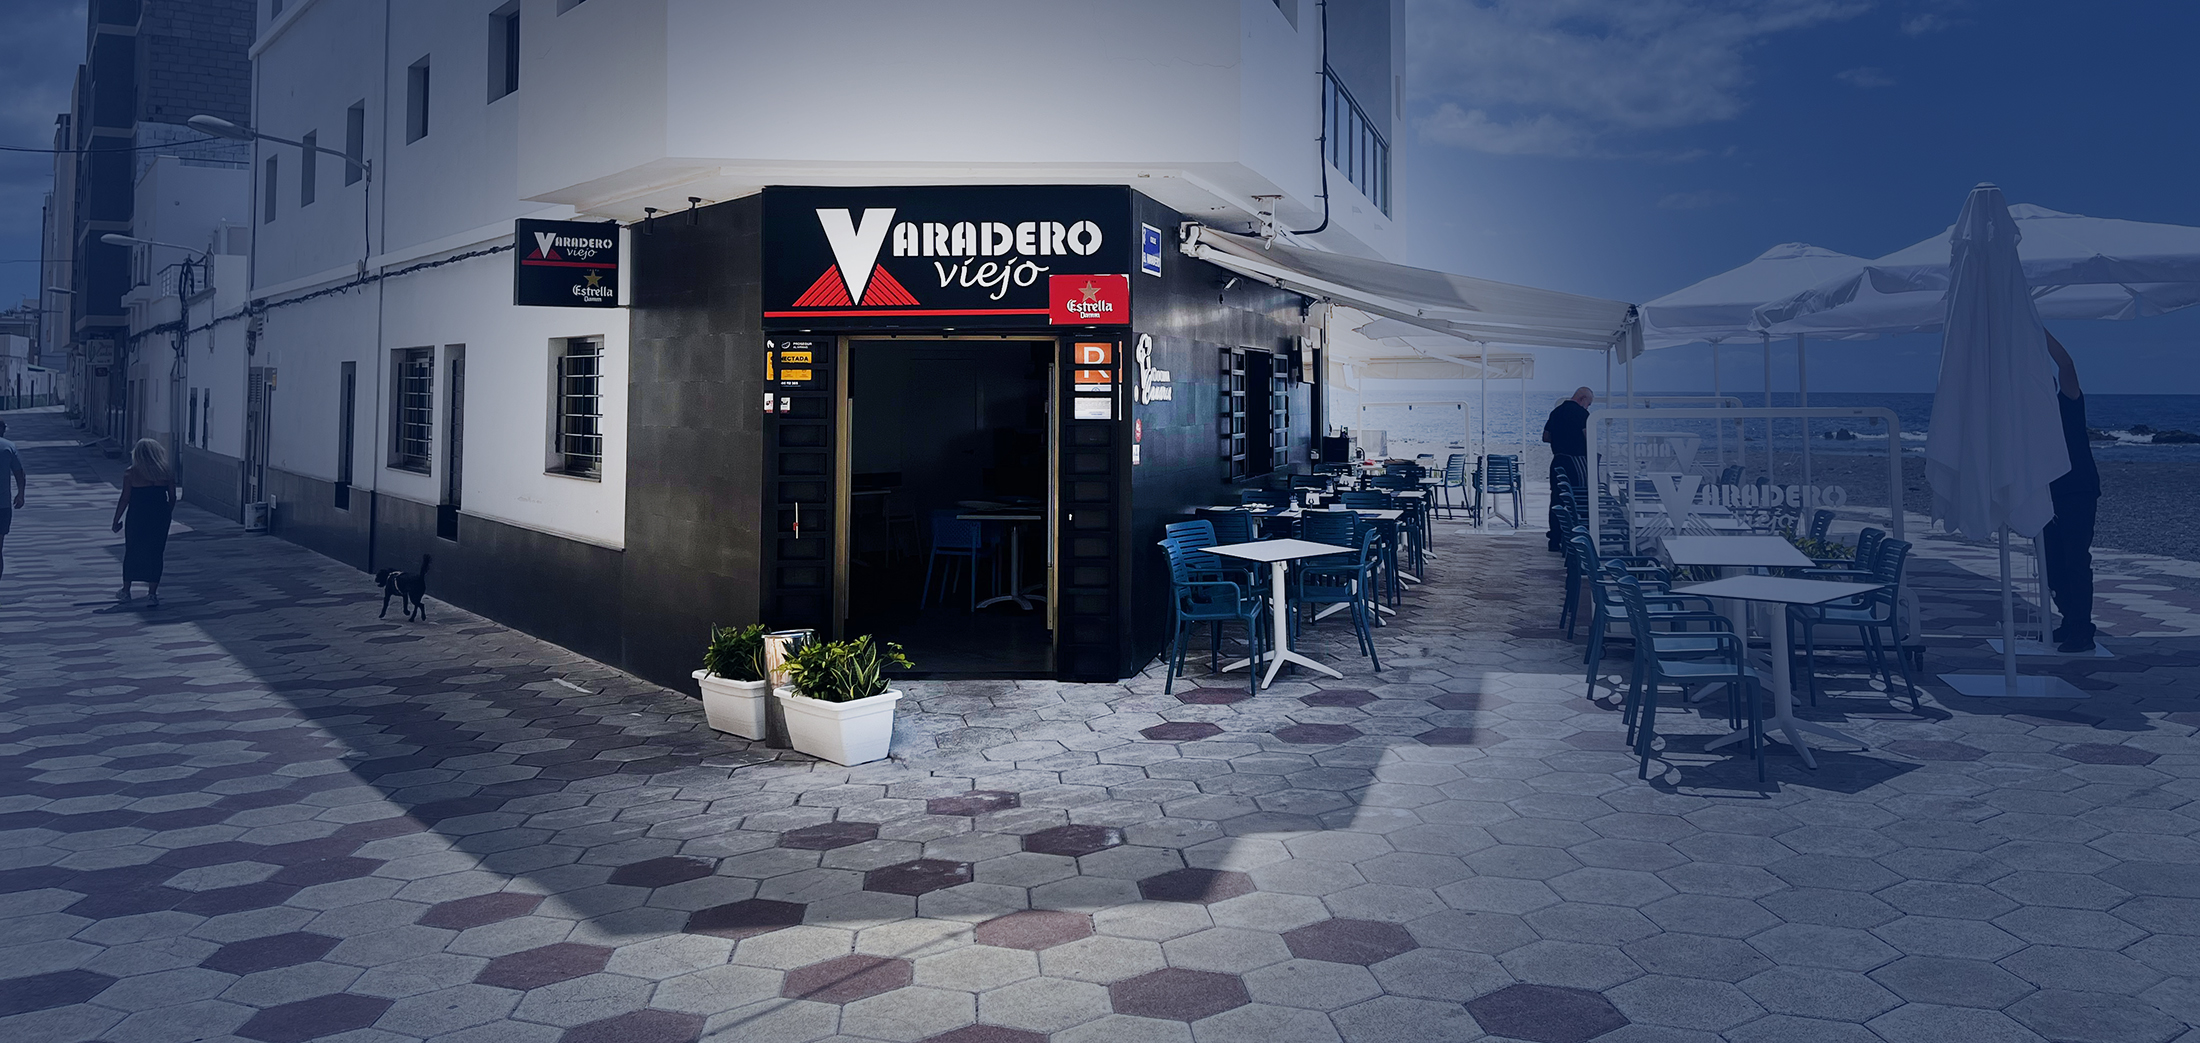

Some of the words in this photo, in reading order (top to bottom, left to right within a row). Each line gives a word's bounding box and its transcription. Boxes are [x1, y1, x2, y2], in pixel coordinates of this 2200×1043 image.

[534, 231, 613, 259] VARADERO
[567, 247, 598, 260] viejo
[815, 208, 1103, 305] VARADERO
[572, 284, 613, 297] Estrella
[934, 257, 1050, 300] viejo
[1066, 299, 1113, 313] Estrella
[1083, 347, 1109, 378] R
[1652, 475, 1848, 537] VARADERO
[1732, 507, 1799, 535] viejo
